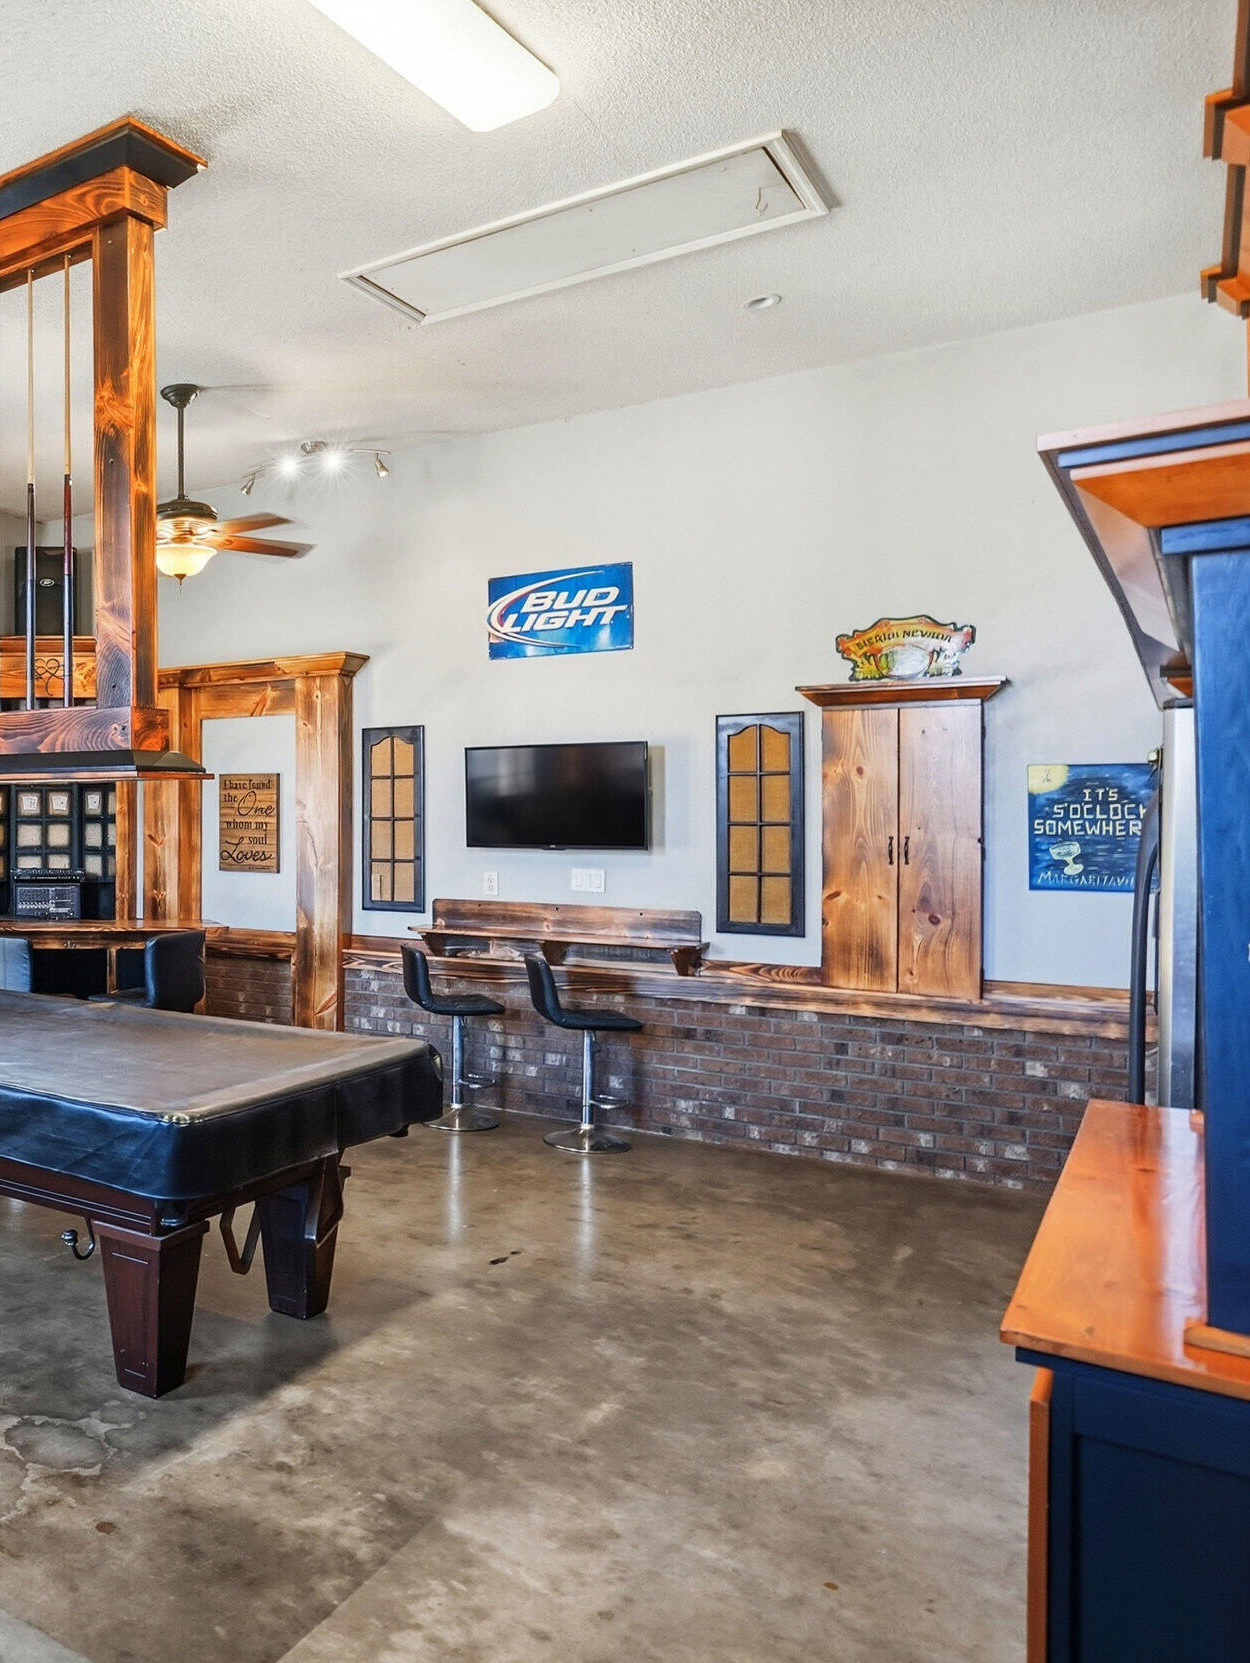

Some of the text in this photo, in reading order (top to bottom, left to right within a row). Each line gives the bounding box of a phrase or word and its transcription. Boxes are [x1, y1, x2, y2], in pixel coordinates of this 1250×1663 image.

[520, 586, 620, 613] BUD
[501, 604, 628, 633] LIGHT
[248, 779, 271, 790] found
[1082, 787, 1119, 802] IT'S
[224, 790, 275, 817] the One
[225, 818, 269, 832] whom my
[1033, 819, 1142, 836] SOMEWHER
[248, 834, 267, 845] soul
[220, 836, 272, 864] Loves
